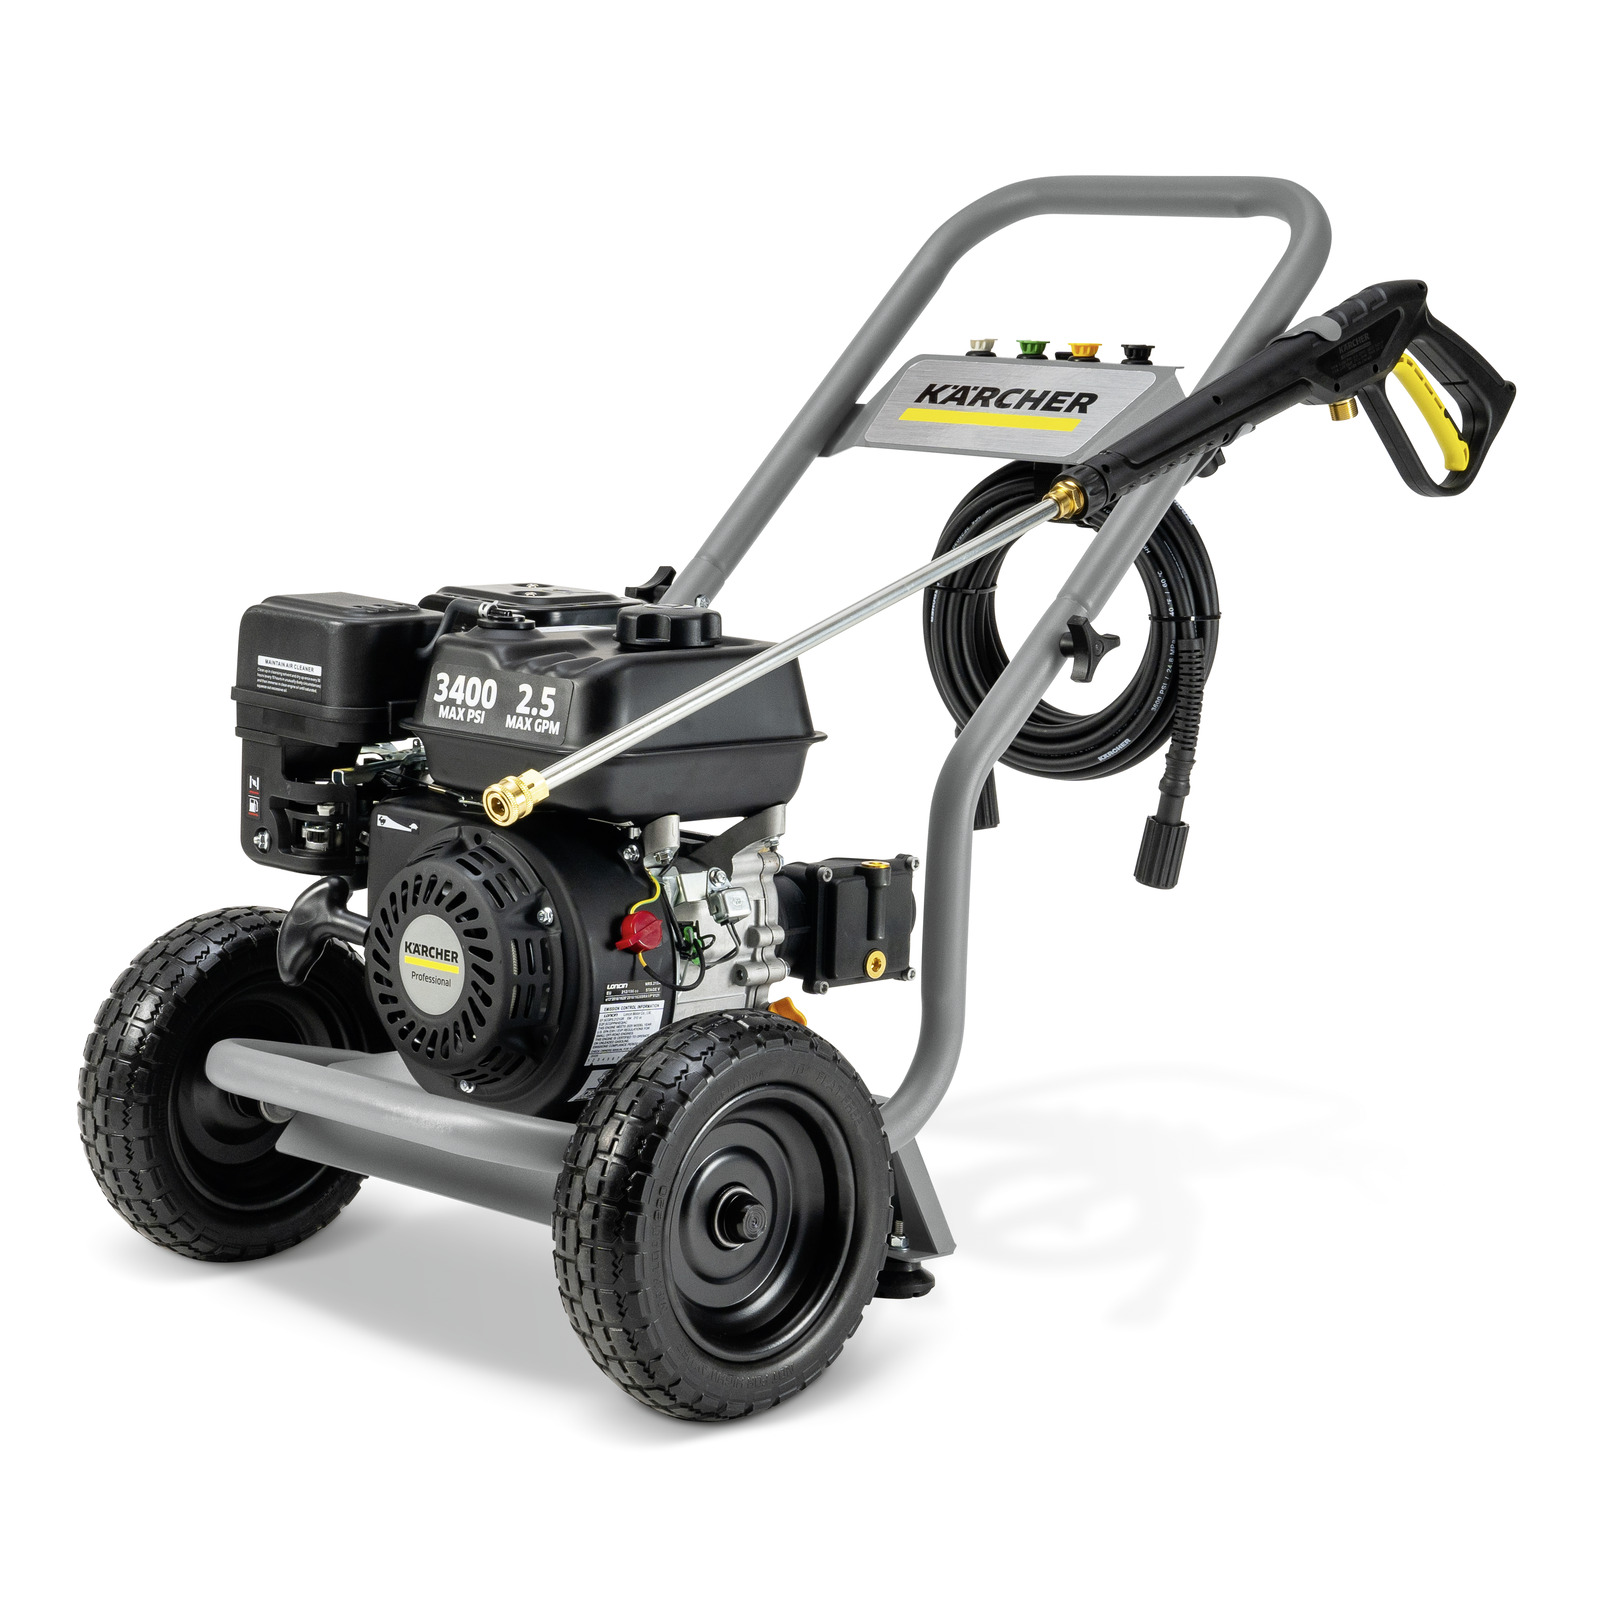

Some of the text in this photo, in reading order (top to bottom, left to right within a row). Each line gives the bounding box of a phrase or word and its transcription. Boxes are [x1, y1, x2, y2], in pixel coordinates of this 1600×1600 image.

[914, 383, 1098, 414] KÄRCHER
[294, 664, 315, 673] CLEANER
[433, 672, 498, 709] 3400
[1159, 682, 1168, 694] PSI
[515, 683, 556, 718] 2.5
[438, 704, 486, 724] MAX PSI
[505, 714, 560, 735] MAX GPM
[404, 941, 459, 964] KÄRCHER
[411, 970, 452, 987] Professional
